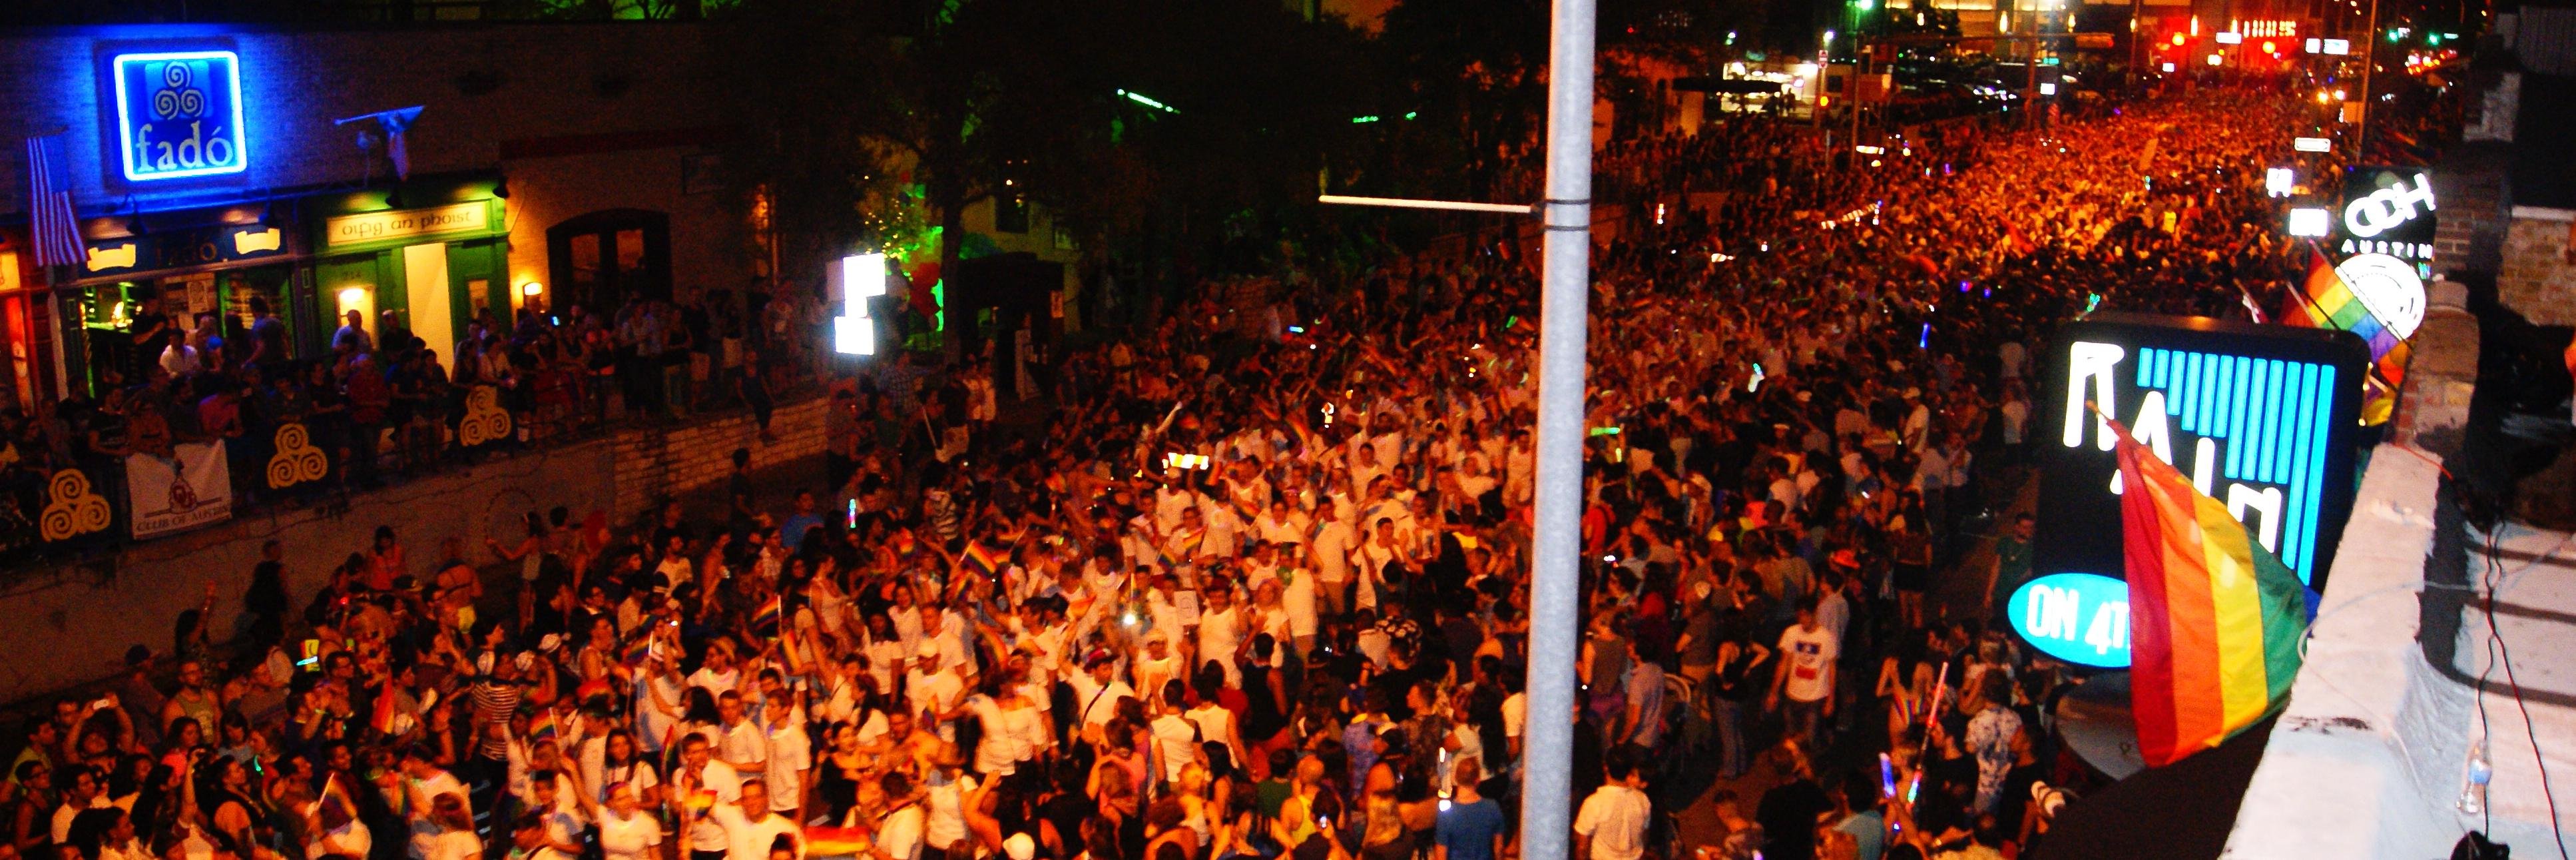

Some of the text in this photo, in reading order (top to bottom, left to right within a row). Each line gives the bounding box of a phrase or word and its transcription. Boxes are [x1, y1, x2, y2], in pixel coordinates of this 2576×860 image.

[136, 120, 234, 172] fadó
[391, 218, 413, 230] an
[419, 210, 473, 230] phoist
[2344, 173, 2436, 237] OCH
[2341, 238, 2434, 259] AUSTIN
[136, 504, 230, 532] CLUB OF AUSTIN
[2026, 584, 2131, 655] ON 4T
